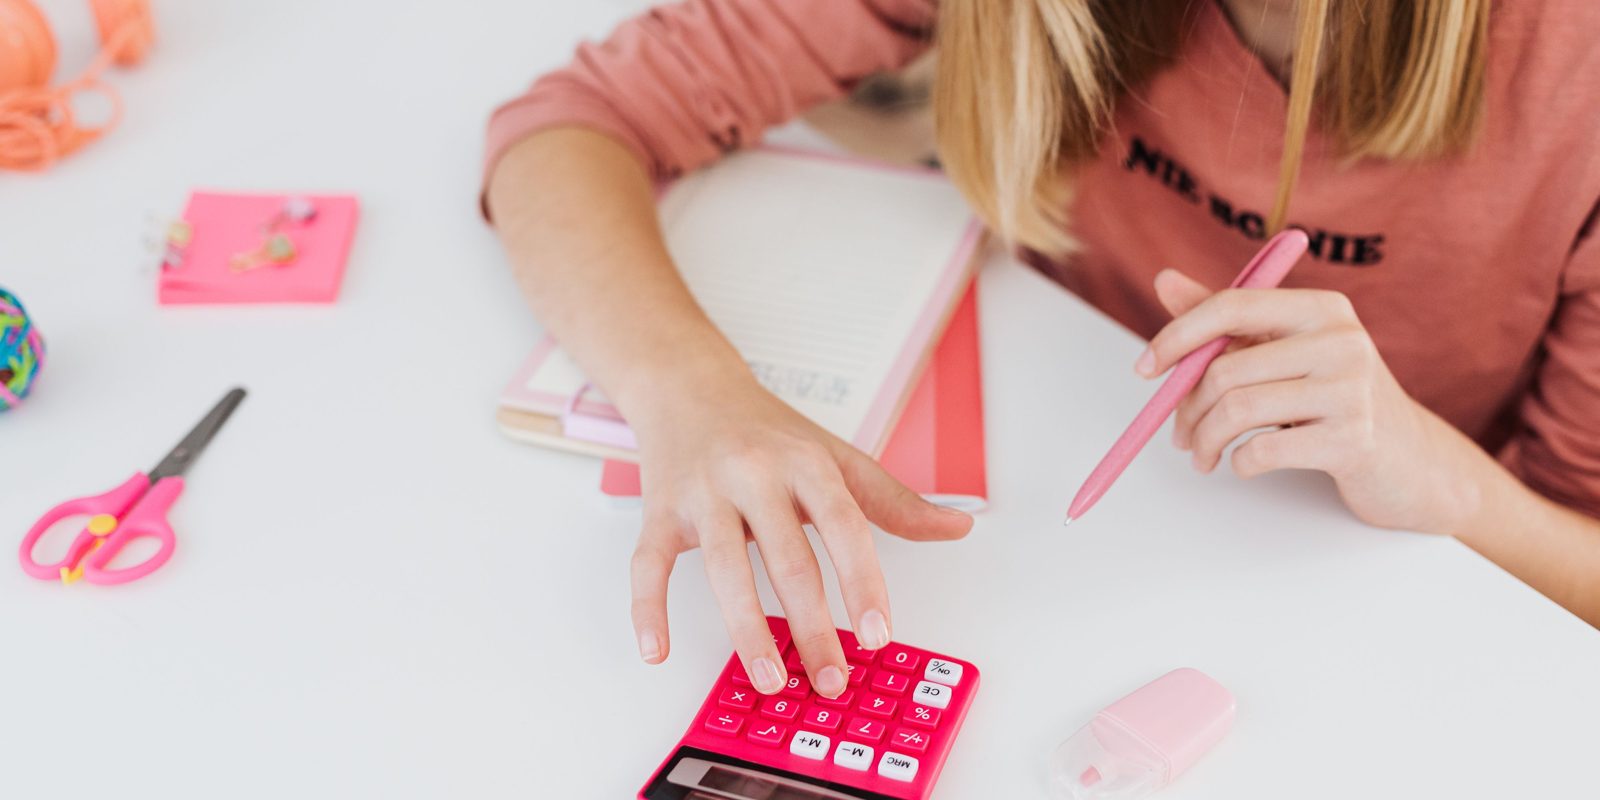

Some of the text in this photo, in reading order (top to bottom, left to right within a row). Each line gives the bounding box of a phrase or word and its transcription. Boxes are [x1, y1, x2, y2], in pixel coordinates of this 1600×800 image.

[895, 652, 907, 663] 0
[787, 677, 799, 688] 6
[886, 674, 895, 686] 1
[921, 685, 940, 696] CE
[775, 701, 788, 712] 9
[873, 697, 885, 708] 4
[817, 711, 829, 723] 8
[915, 707, 930, 720] %
[858, 721, 872, 734] 7
[799, 736, 821, 748] M+
[886, 756, 910, 769] MRC
